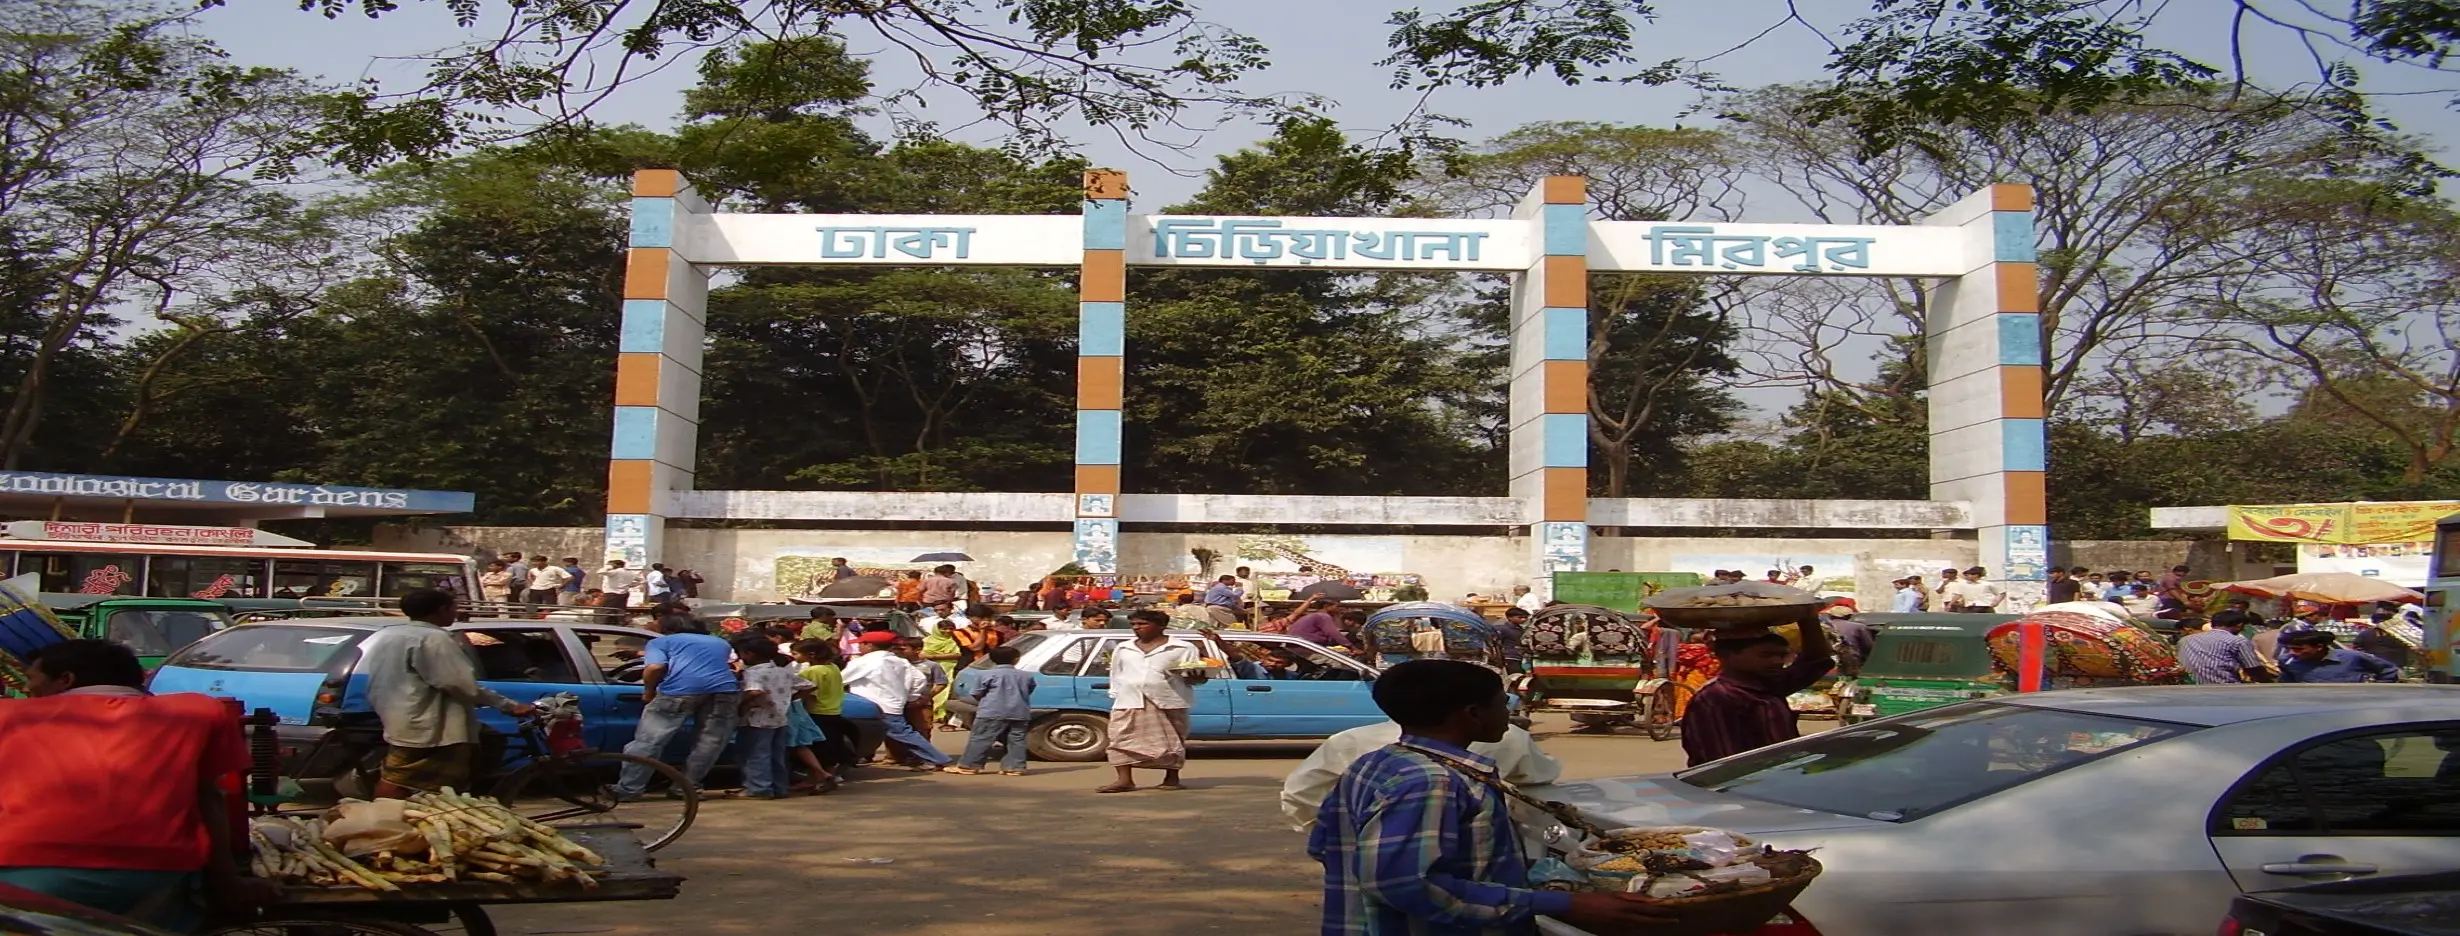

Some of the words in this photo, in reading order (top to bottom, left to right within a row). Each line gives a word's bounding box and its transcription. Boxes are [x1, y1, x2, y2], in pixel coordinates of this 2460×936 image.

[816, 226, 977, 259] ঢাকা
[1150, 219, 1489, 264] চিড়িয়াখানা
[1641, 226, 1876, 273] মিরপুর
[225, 482, 409, 508] Gardens
